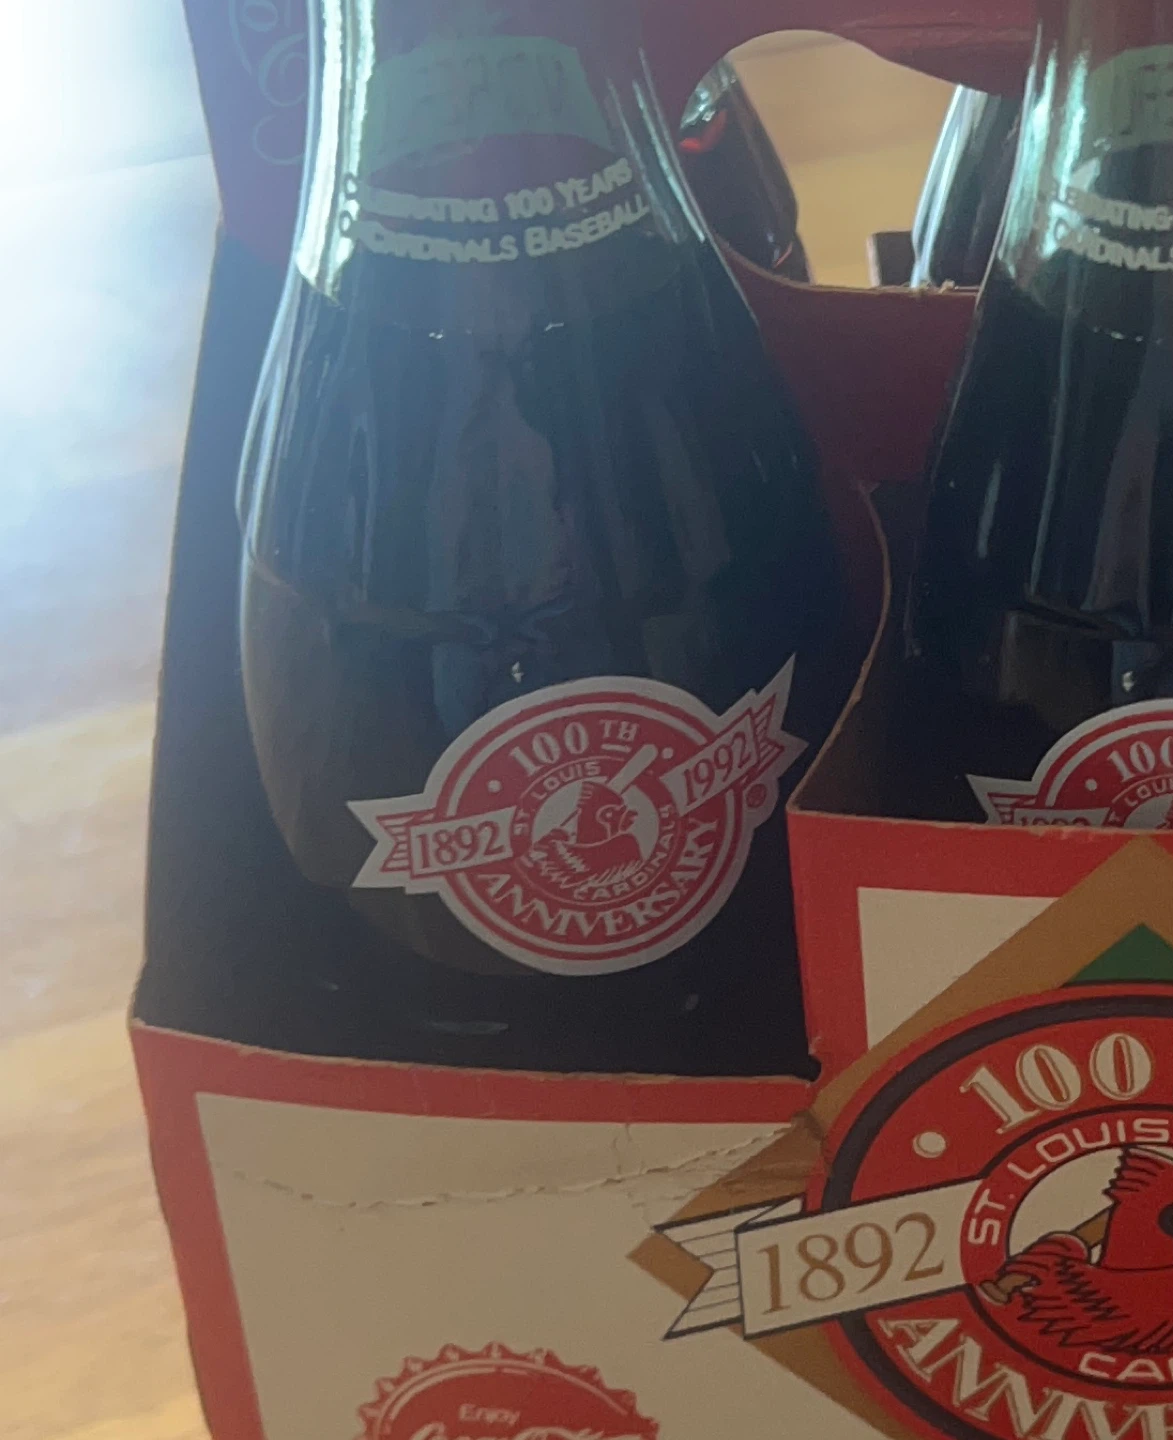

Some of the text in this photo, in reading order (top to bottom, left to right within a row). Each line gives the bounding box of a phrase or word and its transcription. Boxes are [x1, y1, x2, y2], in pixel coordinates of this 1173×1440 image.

[503, 187, 554, 220] 100
[554, 157, 633, 209] YEARS
[524, 193, 651, 258] BASEBALL
[508, 720, 590, 776] 100
[681, 731, 754, 807] 1992
[530, 760, 601, 801] LOUIS
[413, 819, 503, 873] 1892
[477, 815, 722, 938] ANNIVERSARY
[958, 1031, 1155, 1135] 100
[1006, 1117, 1171, 1180] LOUIS
[758, 1210, 945, 1316] 1892
[457, 1403, 520, 1426] Enjoy
